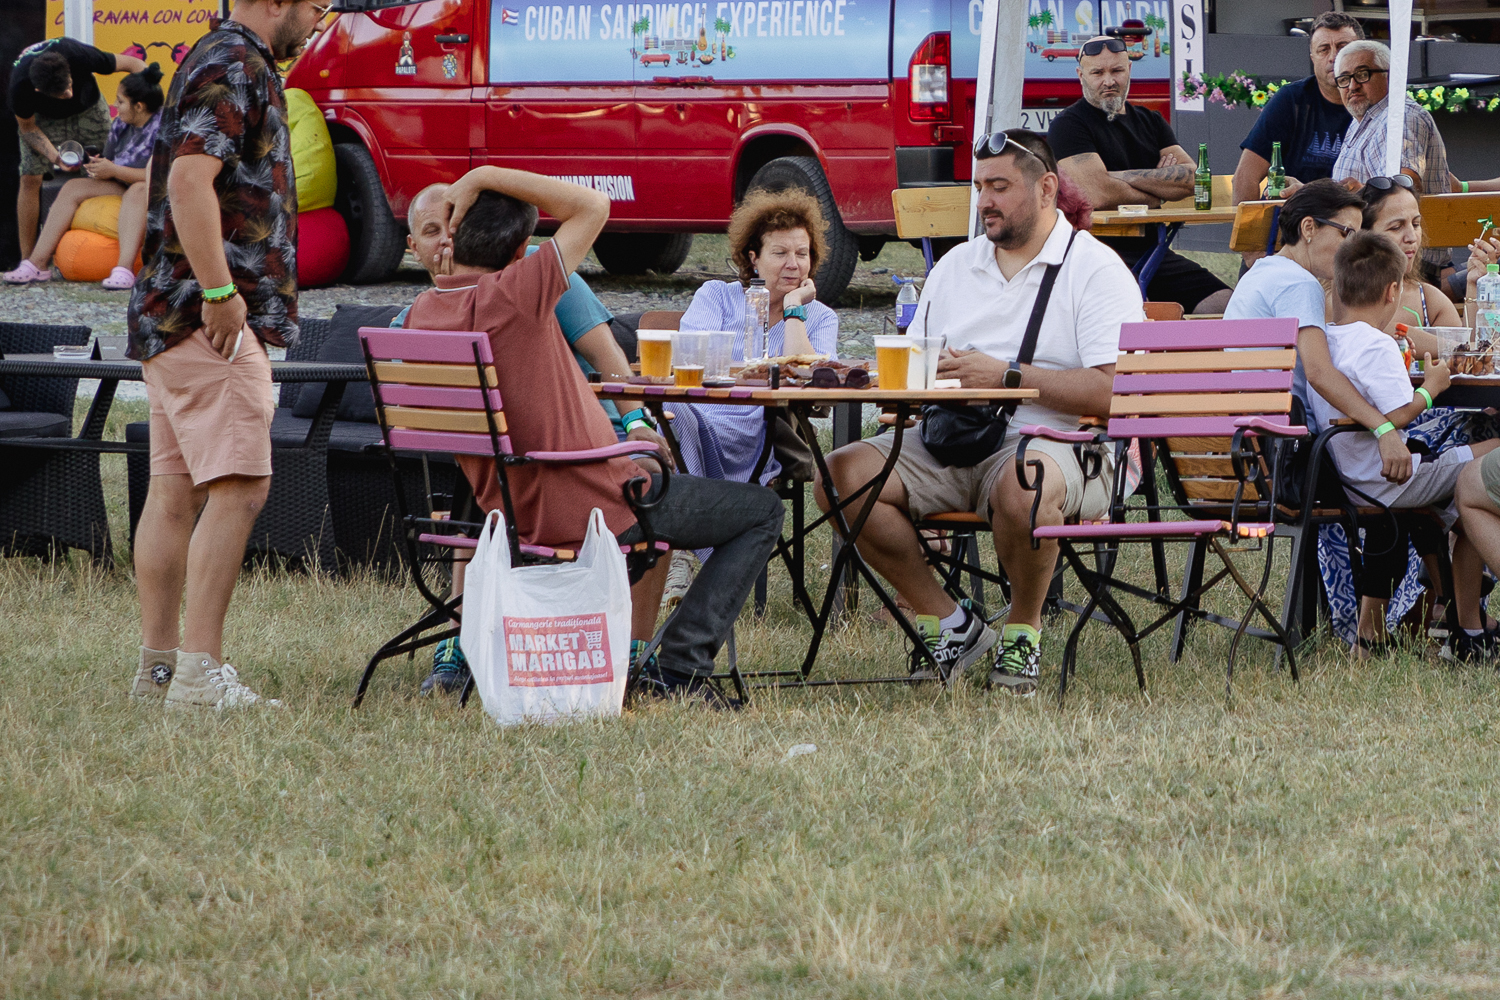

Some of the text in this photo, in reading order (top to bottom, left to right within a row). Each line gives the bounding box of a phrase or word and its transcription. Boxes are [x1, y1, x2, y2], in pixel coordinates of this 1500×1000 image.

[55, 10, 149, 25] CRAVANA
[153, 10, 183, 24] CON
[525, 0, 847, 40] CUBAN SANDWICH EXPERIENCE
[508, 619, 552, 630] Carmangerie
[508, 632, 580, 651] MARKET
[511, 649, 607, 672] MARIGAB
